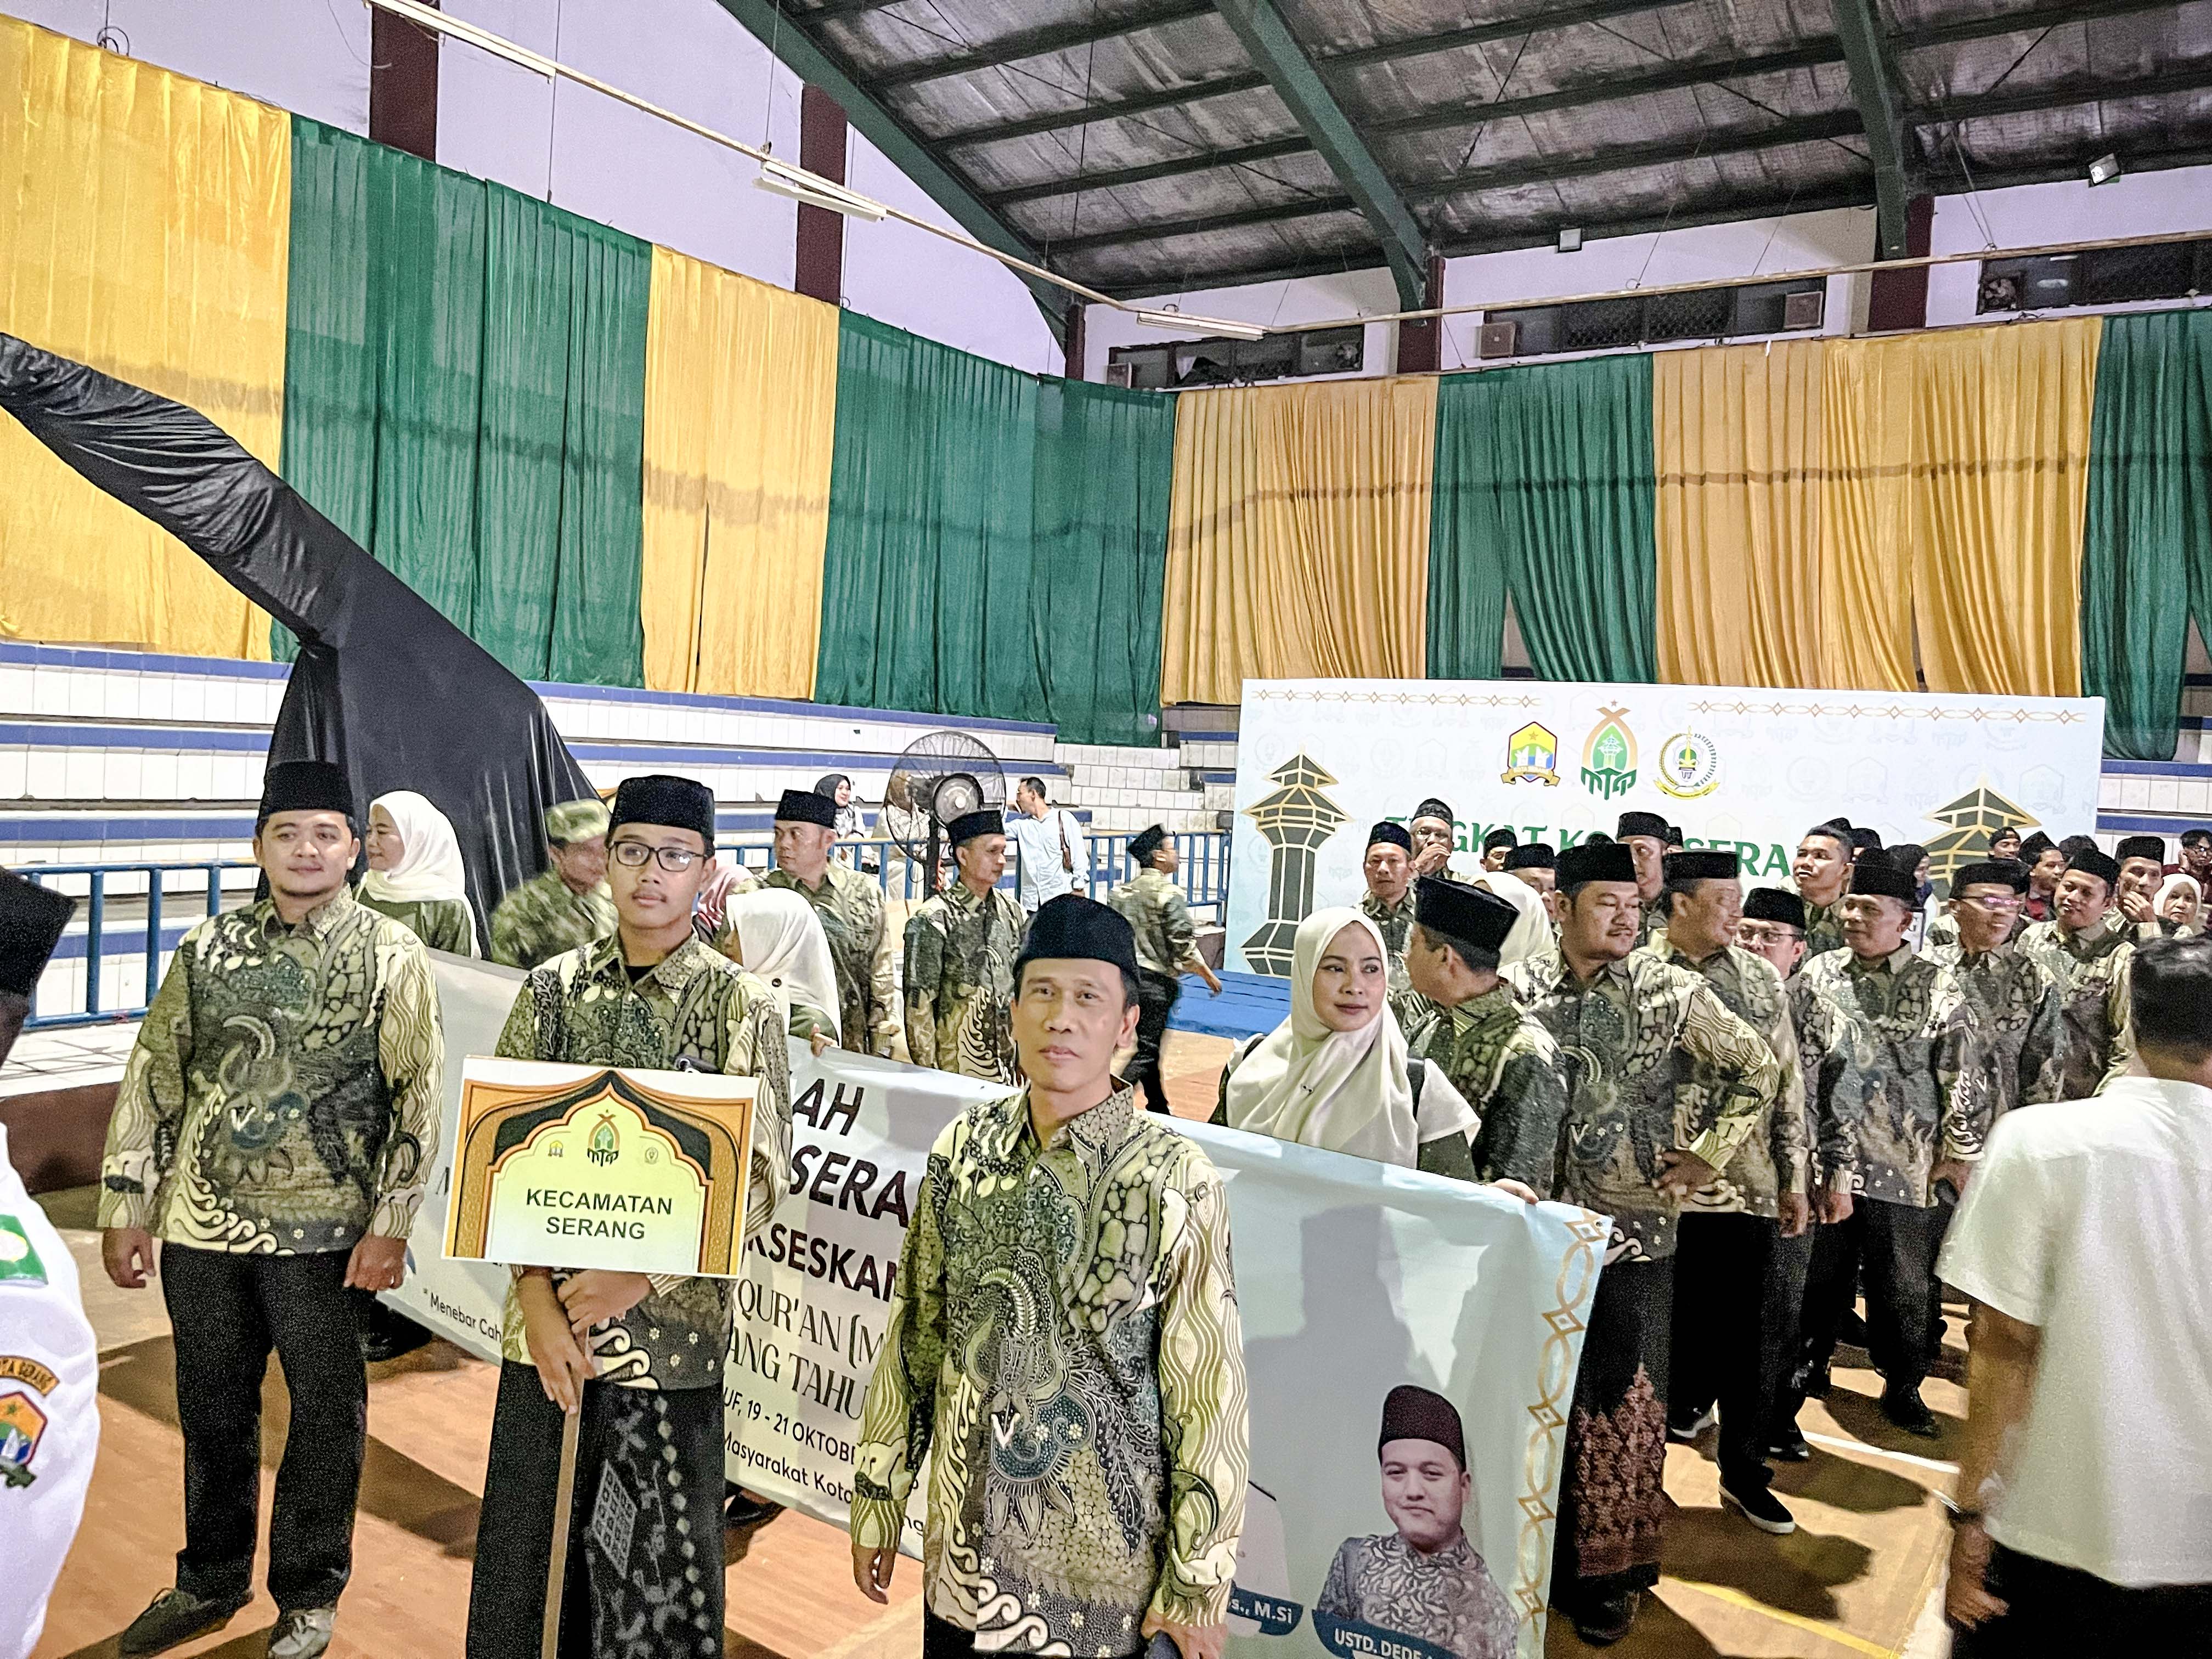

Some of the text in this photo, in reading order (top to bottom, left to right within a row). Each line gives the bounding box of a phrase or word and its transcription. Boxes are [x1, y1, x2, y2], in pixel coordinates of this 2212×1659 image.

[526, 1188, 673, 1215] KECAMATAN
[789, 1144, 925, 1228] SERA
[546, 1216, 645, 1240] SERANG
[430, 1292, 476, 1328] Menebar
[738, 1279, 841, 1352] QUR'AN
[748, 1400, 761, 1420] 19
[774, 1413, 789, 1435] 21
[1229, 1599, 1292, 1624] s., M.Si
